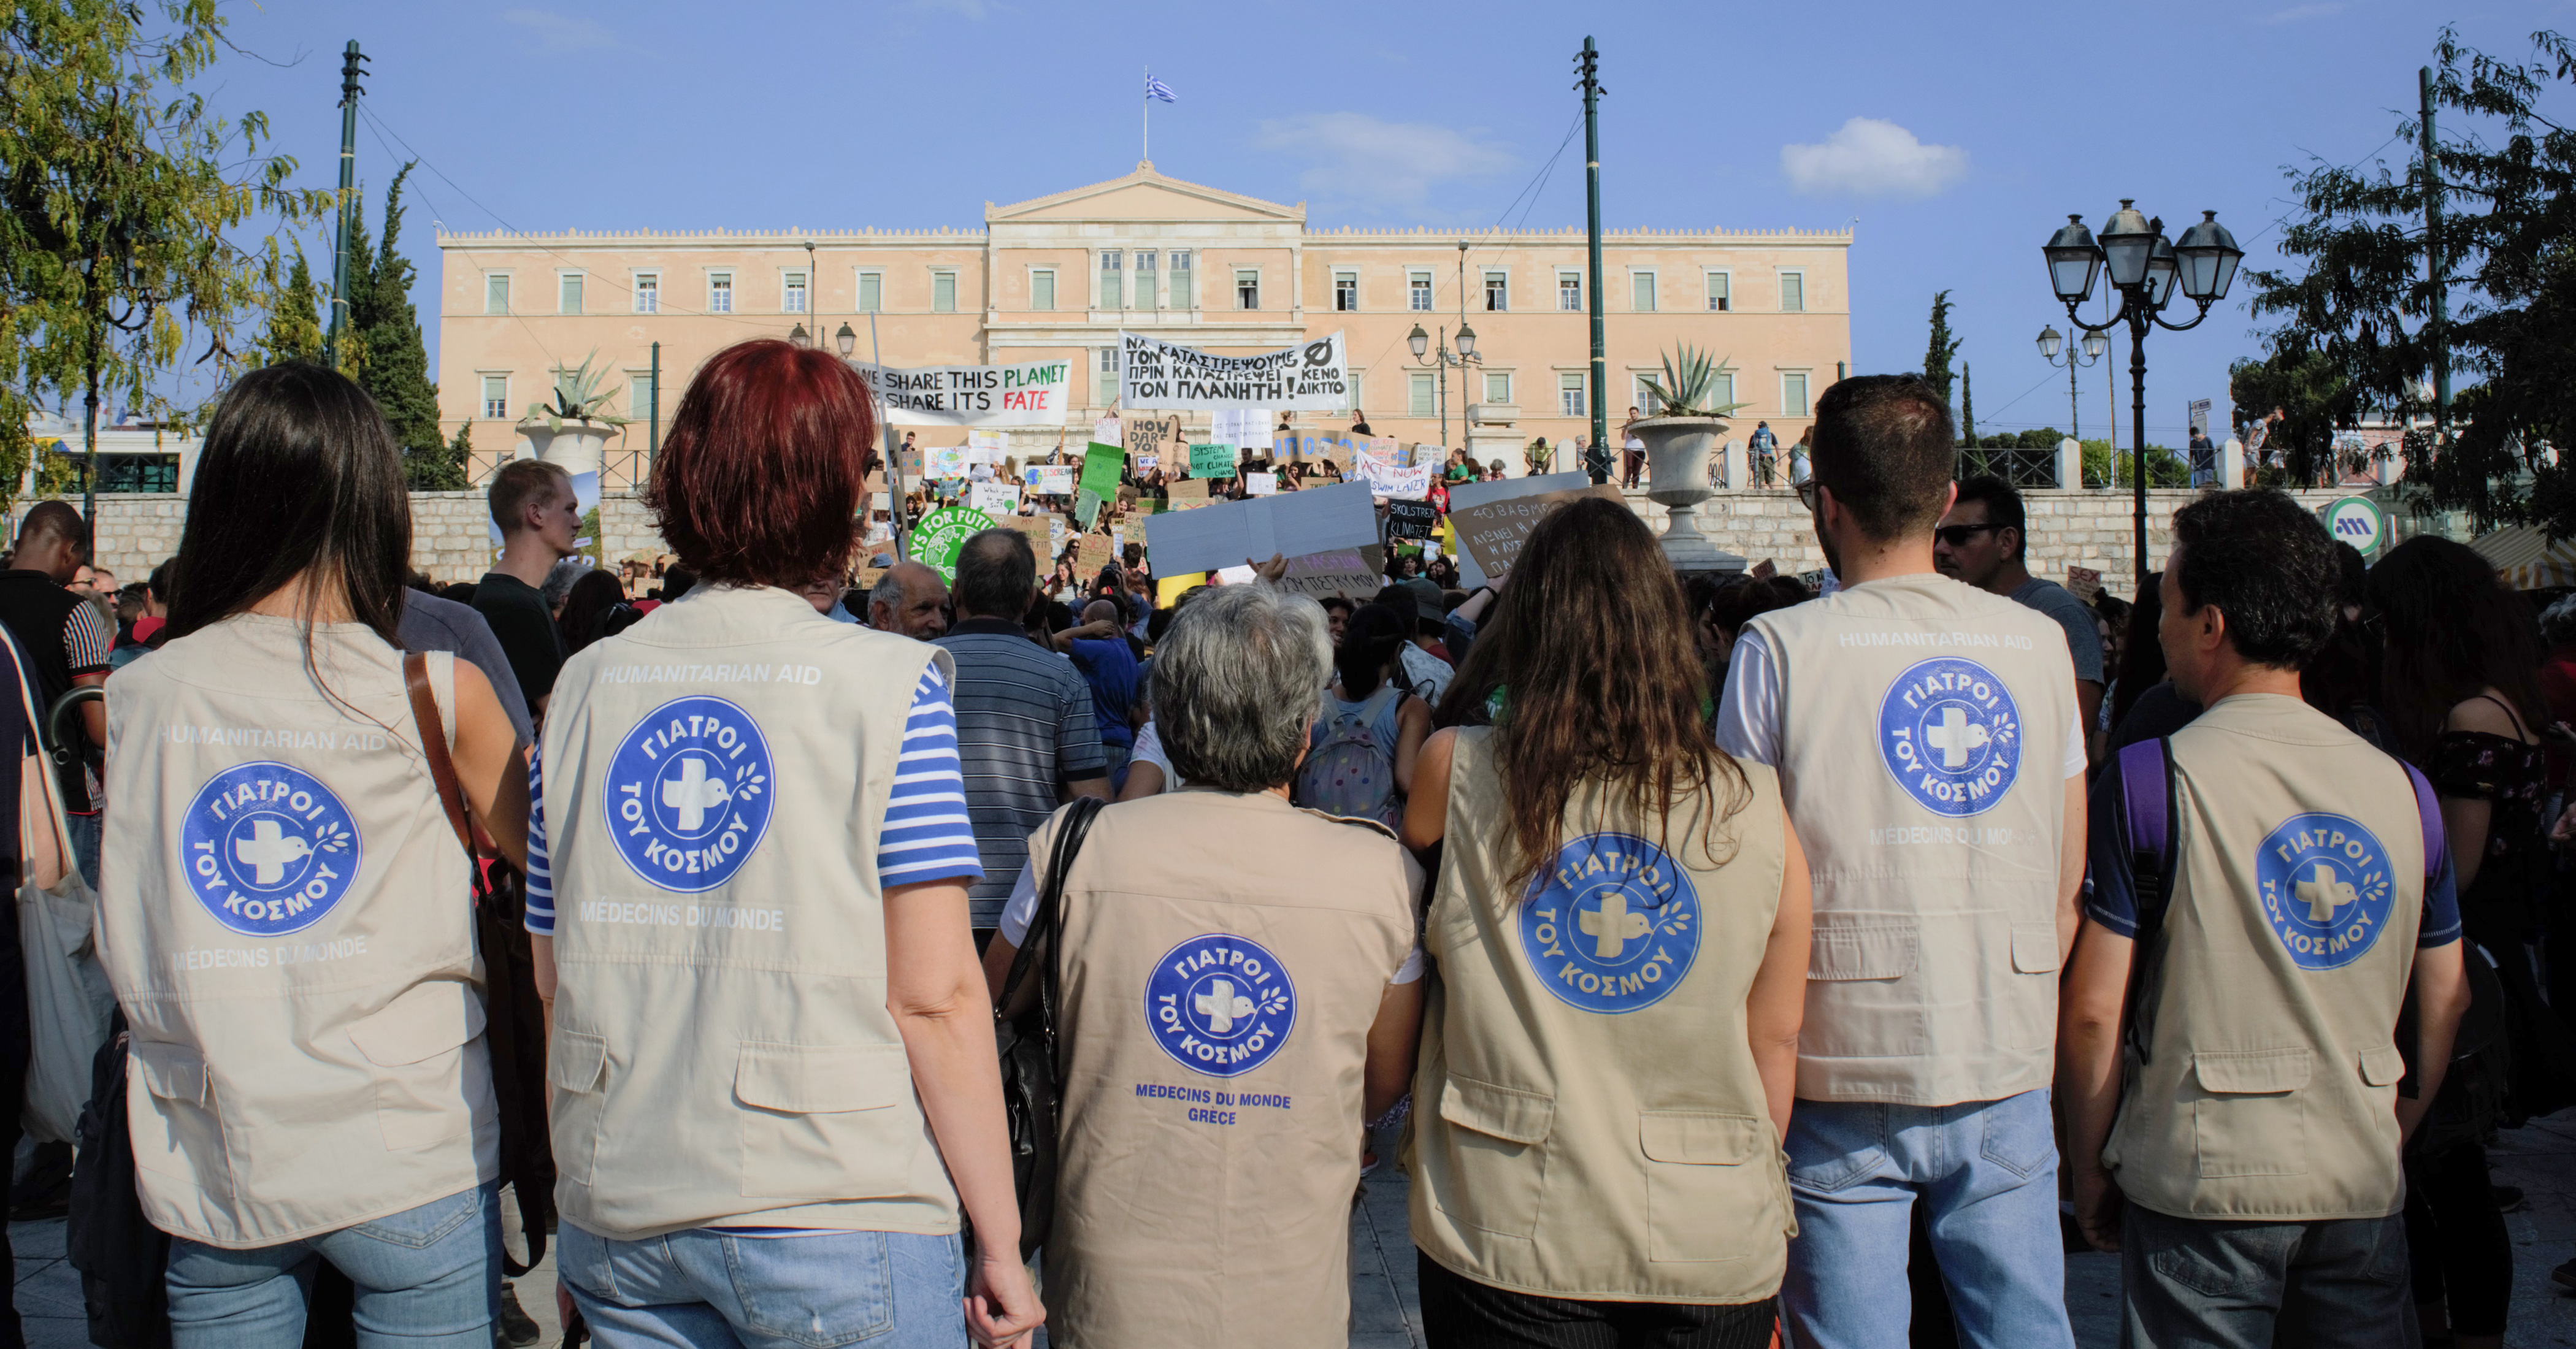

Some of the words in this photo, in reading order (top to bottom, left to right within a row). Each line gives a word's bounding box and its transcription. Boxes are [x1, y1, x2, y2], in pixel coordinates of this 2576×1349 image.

[1126, 337, 1149, 349] ΝΑ
[1126, 350, 1161, 365] ΤΟΝ
[885, 372, 943, 390] SHARE
[948, 370, 998, 388] THIS
[1005, 365, 1067, 388] PLANET
[1129, 365, 1164, 379] ΠΡΙΝ
[1301, 367, 1340, 381] ΚΕΝΟ
[1130, 381, 1168, 399] ΤΟΝ
[1297, 381, 1345, 394] ΔΙΚΤΥΟ
[886, 392, 944, 411] SHARE
[953, 391, 991, 410] ITS
[1004, 391, 1049, 410] FATE
[1133, 420, 1170, 434] HOW
[1194, 445, 1225, 456] SYSTEM
[1207, 460, 1234, 469] CLIMATE
[1362, 460, 1387, 475] ACT
[1393, 466, 1424, 478] NOW
[1371, 481, 1393, 492] SWIM
[1396, 479, 1425, 492] LATER
[1390, 503, 1436, 518] SKOLSTREJK
[1473, 507, 1494, 519] 40
[923, 511, 954, 534] FOR
[1390, 521, 1431, 538] KLIMATET
[1516, 522, 1528, 534] Η
[1084, 534, 1110, 550] SEX
[1490, 545, 1498, 556] Η
[1303, 553, 1364, 571] FASHION
[2071, 567, 2099, 584] SEX
[1839, 632, 1999, 648] HUMANITARIAN
[2004, 635, 2033, 650] AID
[601, 663, 770, 684] HUMANITARIAN
[776, 664, 821, 686] AID
[1903, 673, 1999, 709] ΓΙΑΤΡΟΙ
[158, 725, 335, 750] HUMANITARIAN
[343, 735, 387, 751] AID
[641, 716, 747, 760] ΓΙΑΤΡΟΙ
[1892, 727, 1923, 773] ΤΟΥ
[1920, 751, 2009, 802] ΚΟΣΜΟΥ
[210, 780, 326, 820] ΓΙΑΤΡΟΙ
[621, 781, 651, 837] ΤΟΥ
[644, 812, 749, 874] ΚΟΣΜΟΥ
[1870, 824, 1953, 846] MÉDECINS
[1957, 828, 1982, 844] DU
[2276, 829, 2373, 868] ΓΙΑΤΡΟΙ
[194, 839, 228, 890] ΤΟΥ
[223, 862, 339, 920] ΚΟΣΜΟΥ
[1557, 852, 1671, 896] ΓΙΑΤΡΟΙ
[581, 896, 680, 926] MÉDECINS
[686, 906, 711, 927] DU
[715, 908, 783, 931] MONDE
[2263, 879, 2285, 923] ΤΟΥ
[2283, 910, 2372, 955] ΚΟΣΜΟΥ
[173, 944, 269, 971] MÉDECINS
[276, 947, 298, 965] DU
[303, 935, 367, 963] MONDE
[1536, 908, 1565, 958] ΤΟΥ
[1558, 945, 1673, 996] ΚΟΣΜΟΥ
[1175, 948, 1271, 985] ΓΙΑΤΡΟΙ
[1159, 994, 1185, 1033] ΤΟΥ
[1179, 1021, 1275, 1064] ΚΟΣΜΟΥ
[1136, 1084, 1210, 1103] MEDECINS
[1216, 1092, 1235, 1106] DU
[1240, 1094, 1291, 1109] MONDE
[1188, 1106, 1236, 1125] GRÈCE
